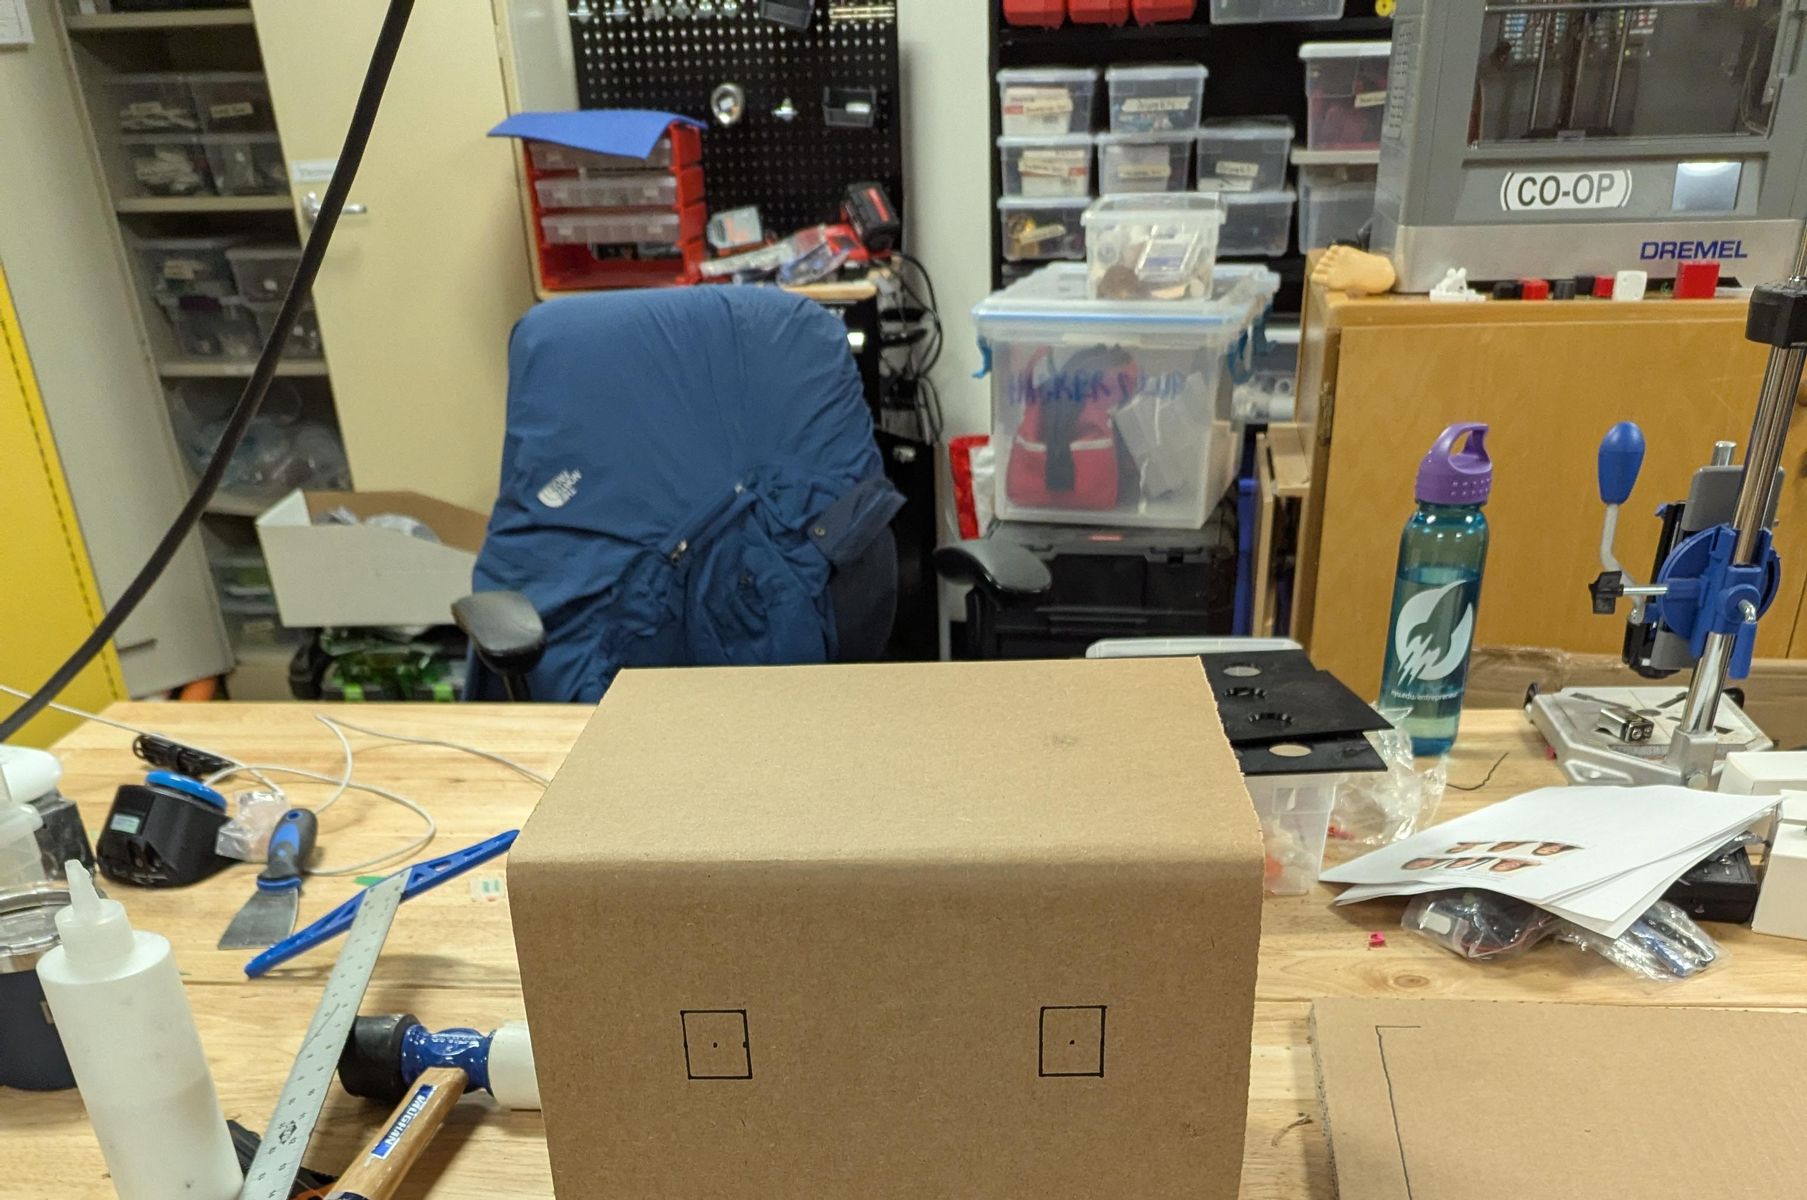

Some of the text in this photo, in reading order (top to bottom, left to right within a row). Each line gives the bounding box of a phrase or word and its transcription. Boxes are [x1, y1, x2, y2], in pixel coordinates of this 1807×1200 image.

[1517, 173, 1615, 206] CO-OP
[1640, 240, 1748, 260] DREMEL
[384, 1094, 426, 1146] VAUGHAN
